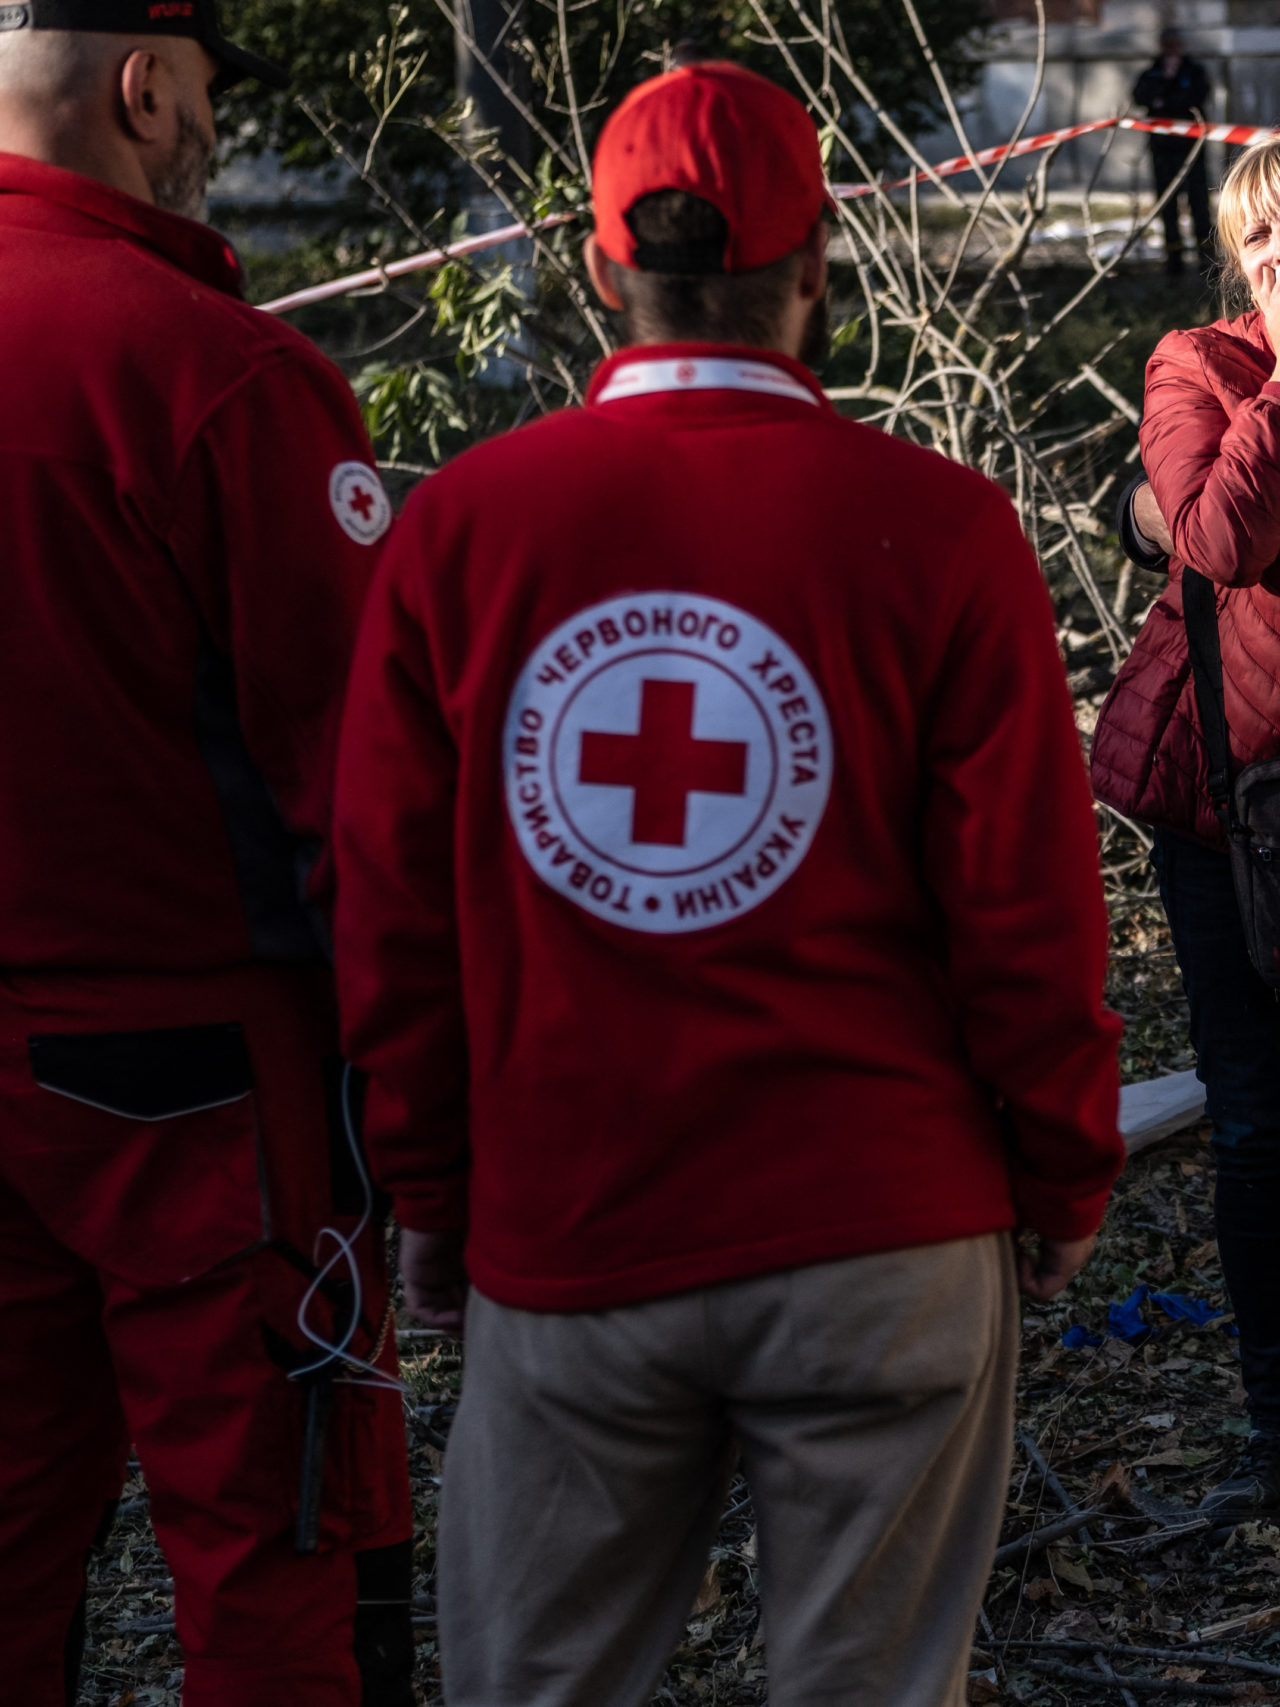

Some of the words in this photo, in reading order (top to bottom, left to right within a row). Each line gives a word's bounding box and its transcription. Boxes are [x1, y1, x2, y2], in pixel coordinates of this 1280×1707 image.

[536, 608, 741, 689] ЧЕРВОНОГО
[750, 650, 819, 788] ХРЕСТА
[514, 708, 633, 913] ТОВАРИСТВО
[672, 813, 806, 919] УКРАЇНИ
